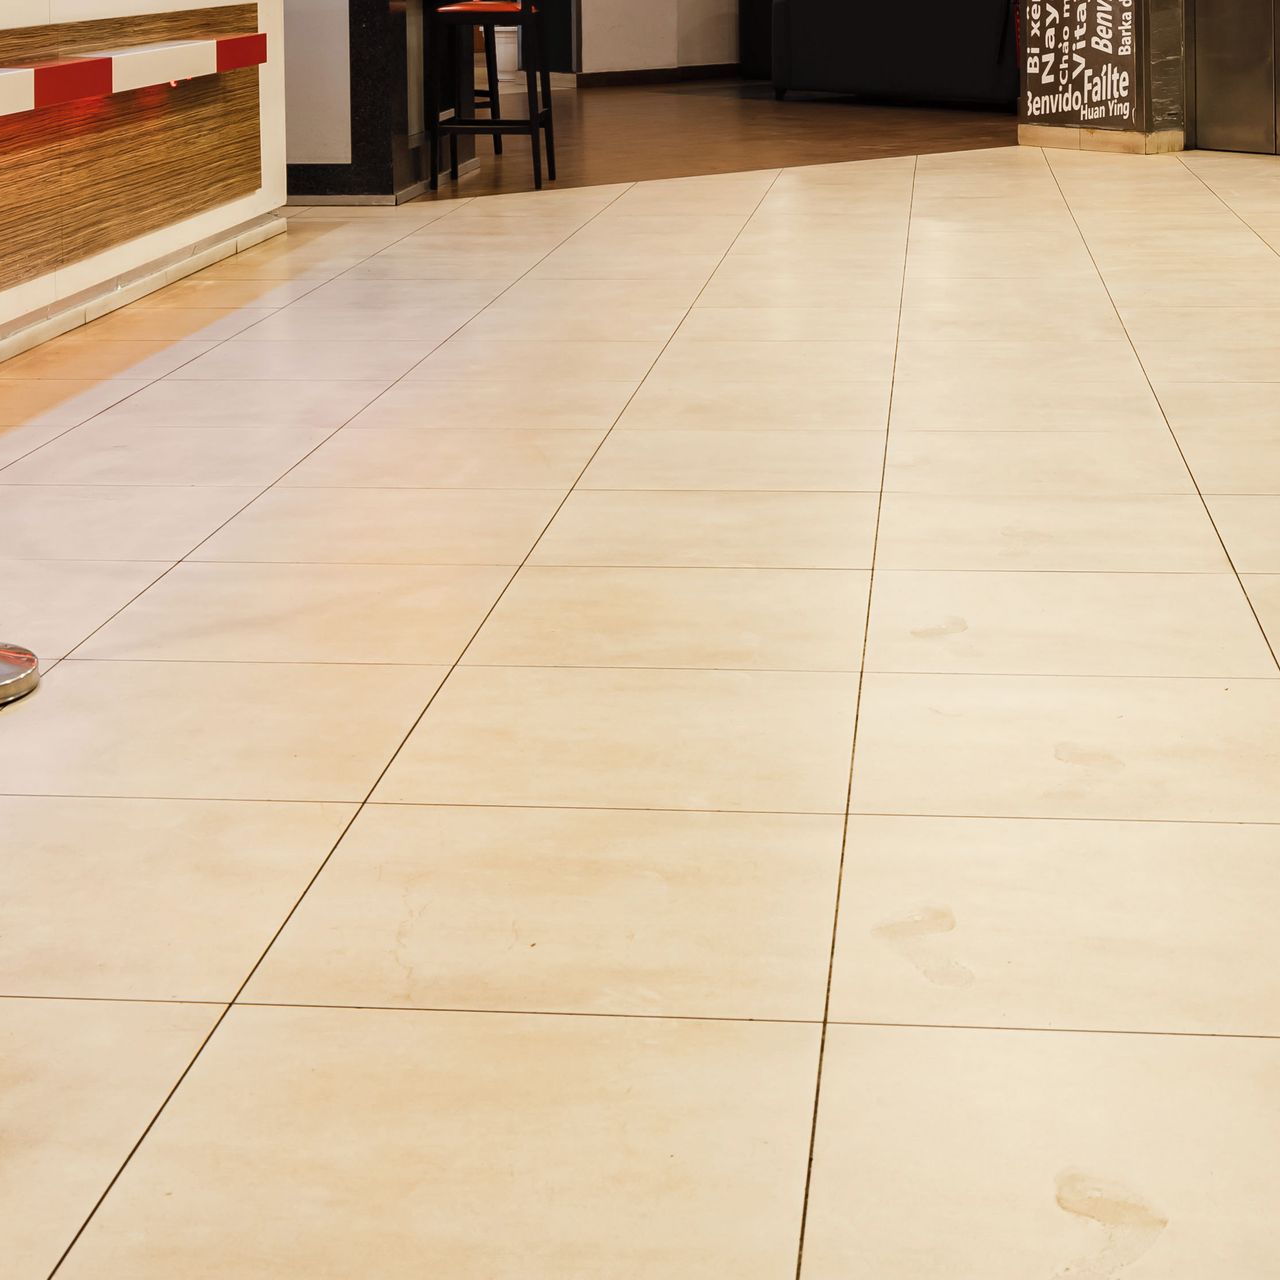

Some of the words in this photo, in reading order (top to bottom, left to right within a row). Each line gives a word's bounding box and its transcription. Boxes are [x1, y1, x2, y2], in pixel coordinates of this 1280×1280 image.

[1118, 14, 1132, 56] Barka
[1027, 47, 1040, 73] Bi
[1080, 103, 1105, 120] Huan
[1108, 99, 1130, 119] Ying
